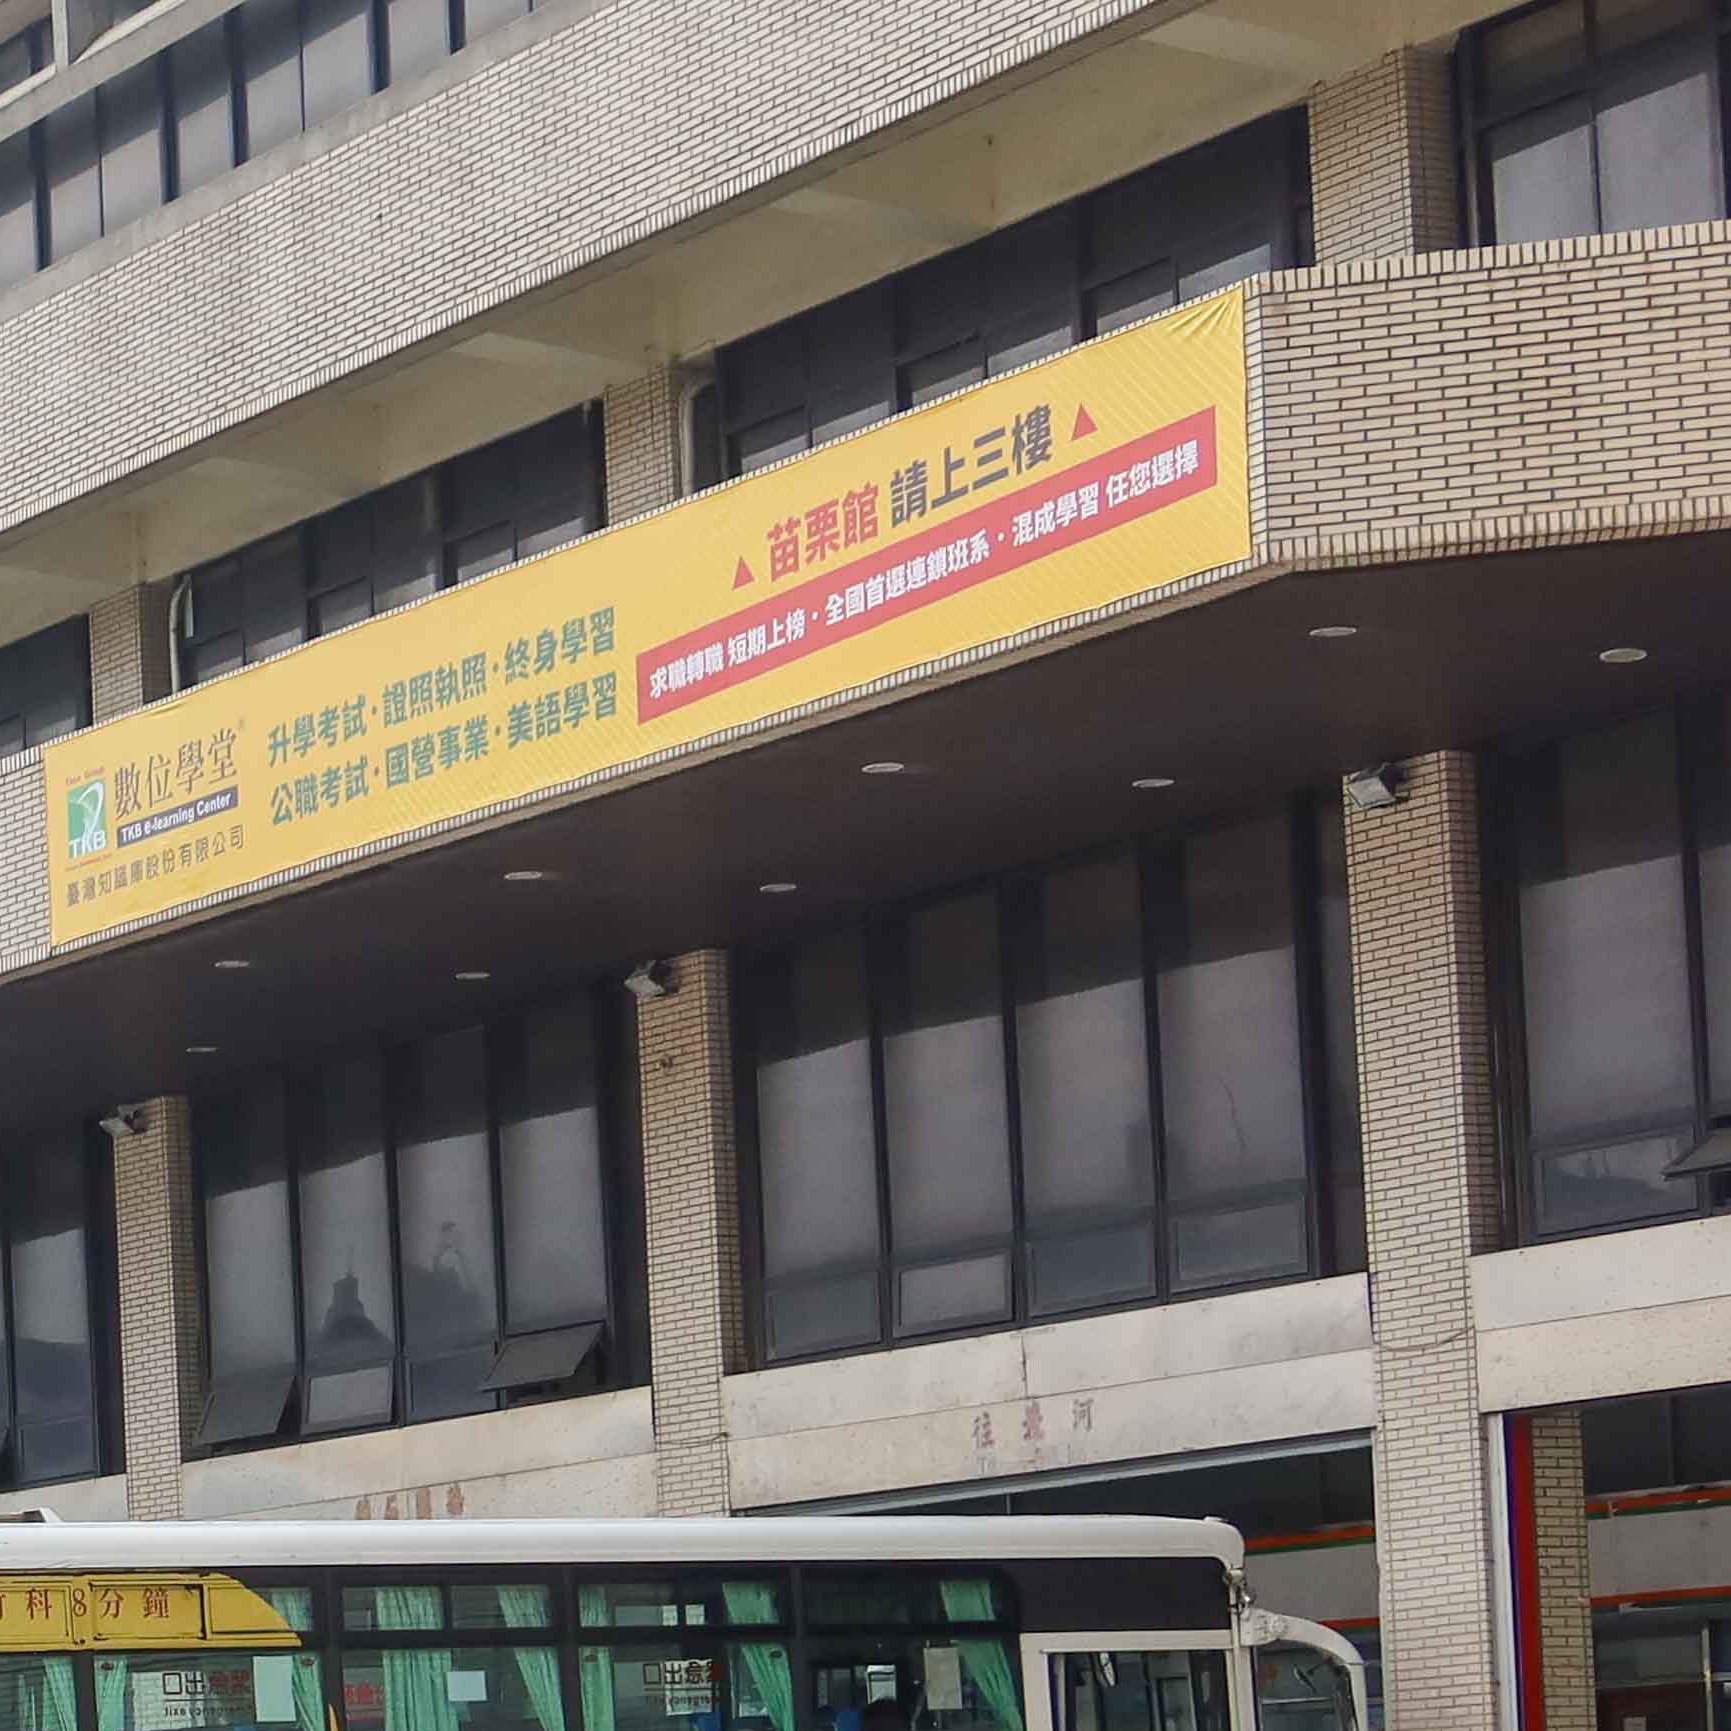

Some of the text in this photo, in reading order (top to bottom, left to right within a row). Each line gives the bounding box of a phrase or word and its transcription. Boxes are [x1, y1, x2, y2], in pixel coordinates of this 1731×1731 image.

[767, 403, 1053, 582] 苗栗館 請上三樓
[1105, 439, 1200, 507] 任您選擇
[114, 728, 238, 821] 數位學堂
[69, 829, 107, 858] TKB
[120, 792, 232, 843] TKB e-learning Center
